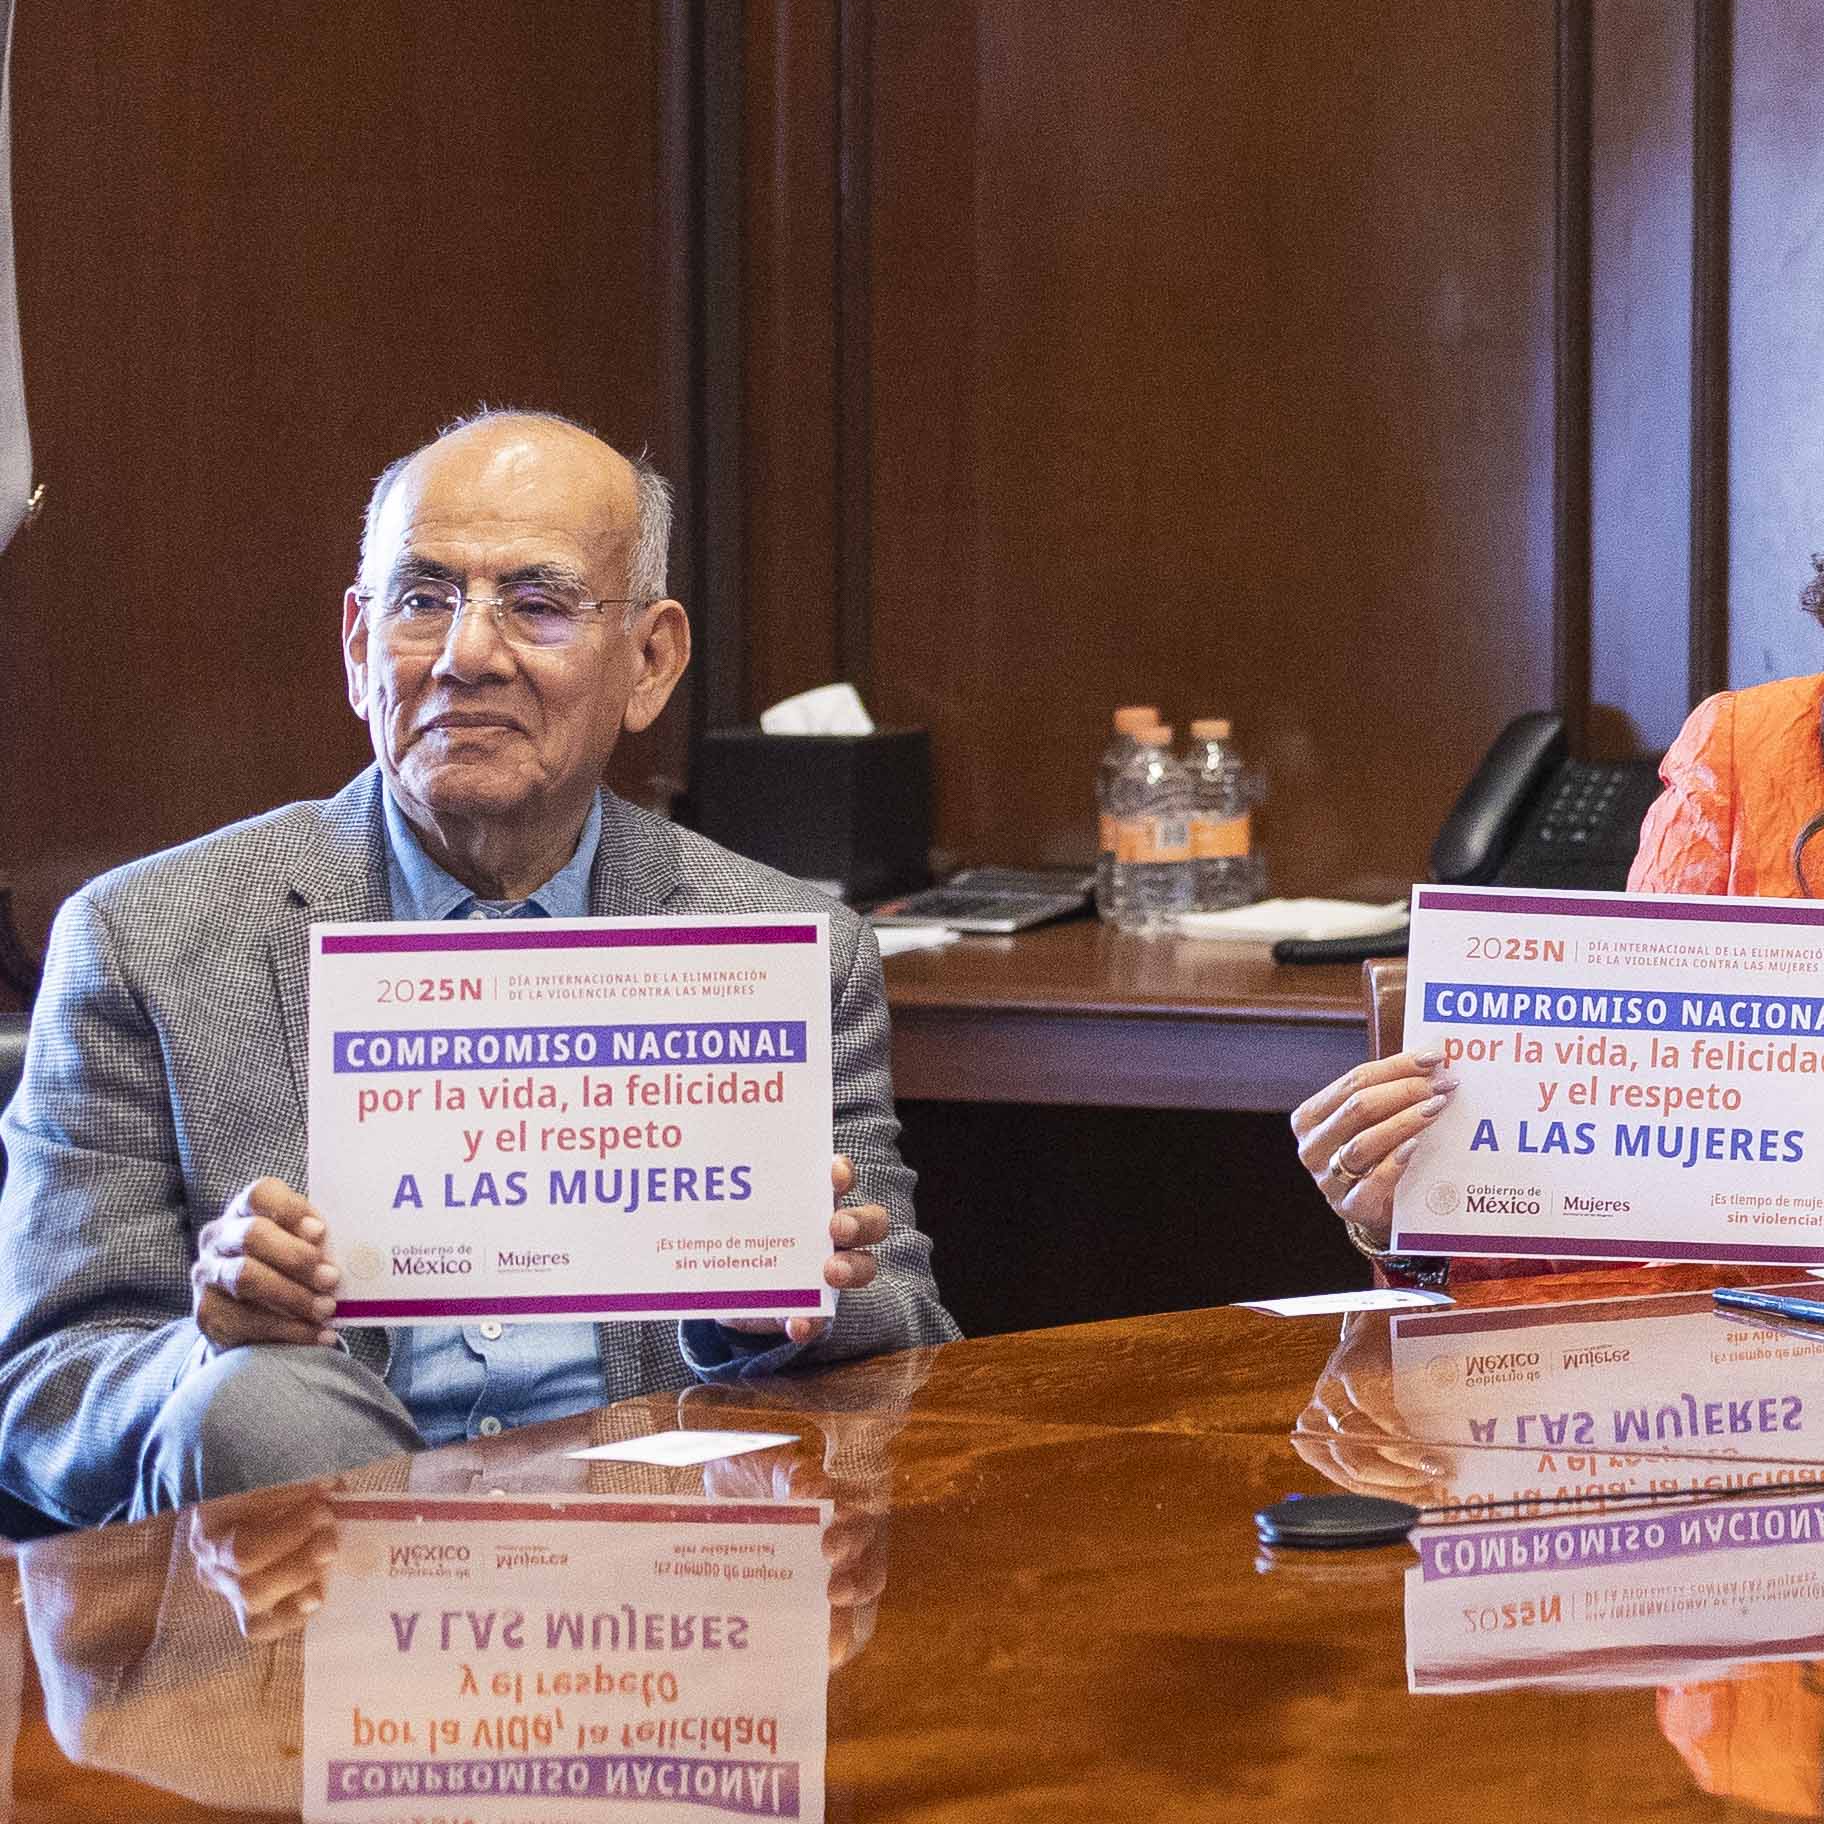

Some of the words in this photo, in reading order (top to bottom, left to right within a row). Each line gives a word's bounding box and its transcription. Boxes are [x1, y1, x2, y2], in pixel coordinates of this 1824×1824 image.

[1464, 935, 1565, 963] 2025N
[1588, 940, 1610, 952] DÍA
[1612, 941, 1711, 956] INTERNACIONAL
[1714, 945, 1730, 956] DE
[1732, 946, 1747, 957] LA
[1587, 953, 1602, 965] DE
[1605, 954, 1620, 965] LA
[1622, 955, 1689, 968] VIOLENCIA
[1691, 957, 1741, 970] CONTRA
[1742, 959, 1764, 971] LAS
[1768, 960, 1819, 975] MUJERES
[508, 974, 532, 986] DÍA
[535, 972, 639, 986] INTERNACIONAL
[643, 972, 659, 983] DE
[663, 971, 678, 983] LA
[682, 969, 768, 982] ELIMINACIÓN
[376, 976, 483, 1004] 2025N
[508, 989, 525, 1001] DE
[528, 988, 544, 1000] LA
[547, 987, 617, 1000] VIOLENCIA
[620, 985, 673, 998] CONTRA
[674, 985, 698, 997] LAS
[701, 984, 754, 999] MUJERES
[1434, 989, 1669, 1025] COMPROMISO
[346, 1032, 597, 1068] COMPROMISO
[612, 1028, 795, 1061] NACIONAL
[1442, 1036, 1504, 1070] por
[1513, 1032, 1544, 1064] la
[1553, 1034, 1640, 1071] vida,
[1650, 1037, 1680, 1069] la
[357, 1086, 422, 1122] por
[434, 1078, 466, 1112] la
[478, 1076, 568, 1114] vida,
[582, 1075, 614, 1108] la
[625, 1071, 785, 1107] felicidad
[1536, 1082, 1558, 1113] y
[1567, 1075, 1598, 1105] el
[1608, 1080, 1743, 1119] respeto
[462, 1130, 483, 1163] y
[494, 1120, 527, 1152] el
[540, 1120, 683, 1161] respeto
[1469, 1118, 1501, 1152] A
[1517, 1120, 1597, 1155] LAS
[1613, 1123, 1805, 1172] MUJERES
[391, 1173, 423, 1209] A
[443, 1170, 528, 1208] LAS
[548, 1165, 753, 1215] MUJERES
[1466, 1184, 1524, 1196] Gobierno
[1526, 1186, 1542, 1197] de
[1709, 1193, 1728, 1207] ¡Es
[1729, 1194, 1773, 1208] tiempo
[1775, 1195, 1790, 1207] de
[1465, 1194, 1541, 1215] México
[1563, 1196, 1631, 1215] Mujeres
[1726, 1212, 1749, 1224] sin
[1751, 1212, 1823, 1227] violencia!
[391, 1244, 453, 1256] Gobierno
[456, 1244, 472, 1254] de
[655, 1238, 674, 1253] ¡Es
[676, 1237, 723, 1252] tiempo
[725, 1236, 741, 1249] de
[744, 1235, 796, 1251] mujeres
[391, 1254, 472, 1276] México
[497, 1249, 570, 1270] Mujeres
[674, 1257, 700, 1270] sin
[702, 1255, 778, 1270] violencia!
